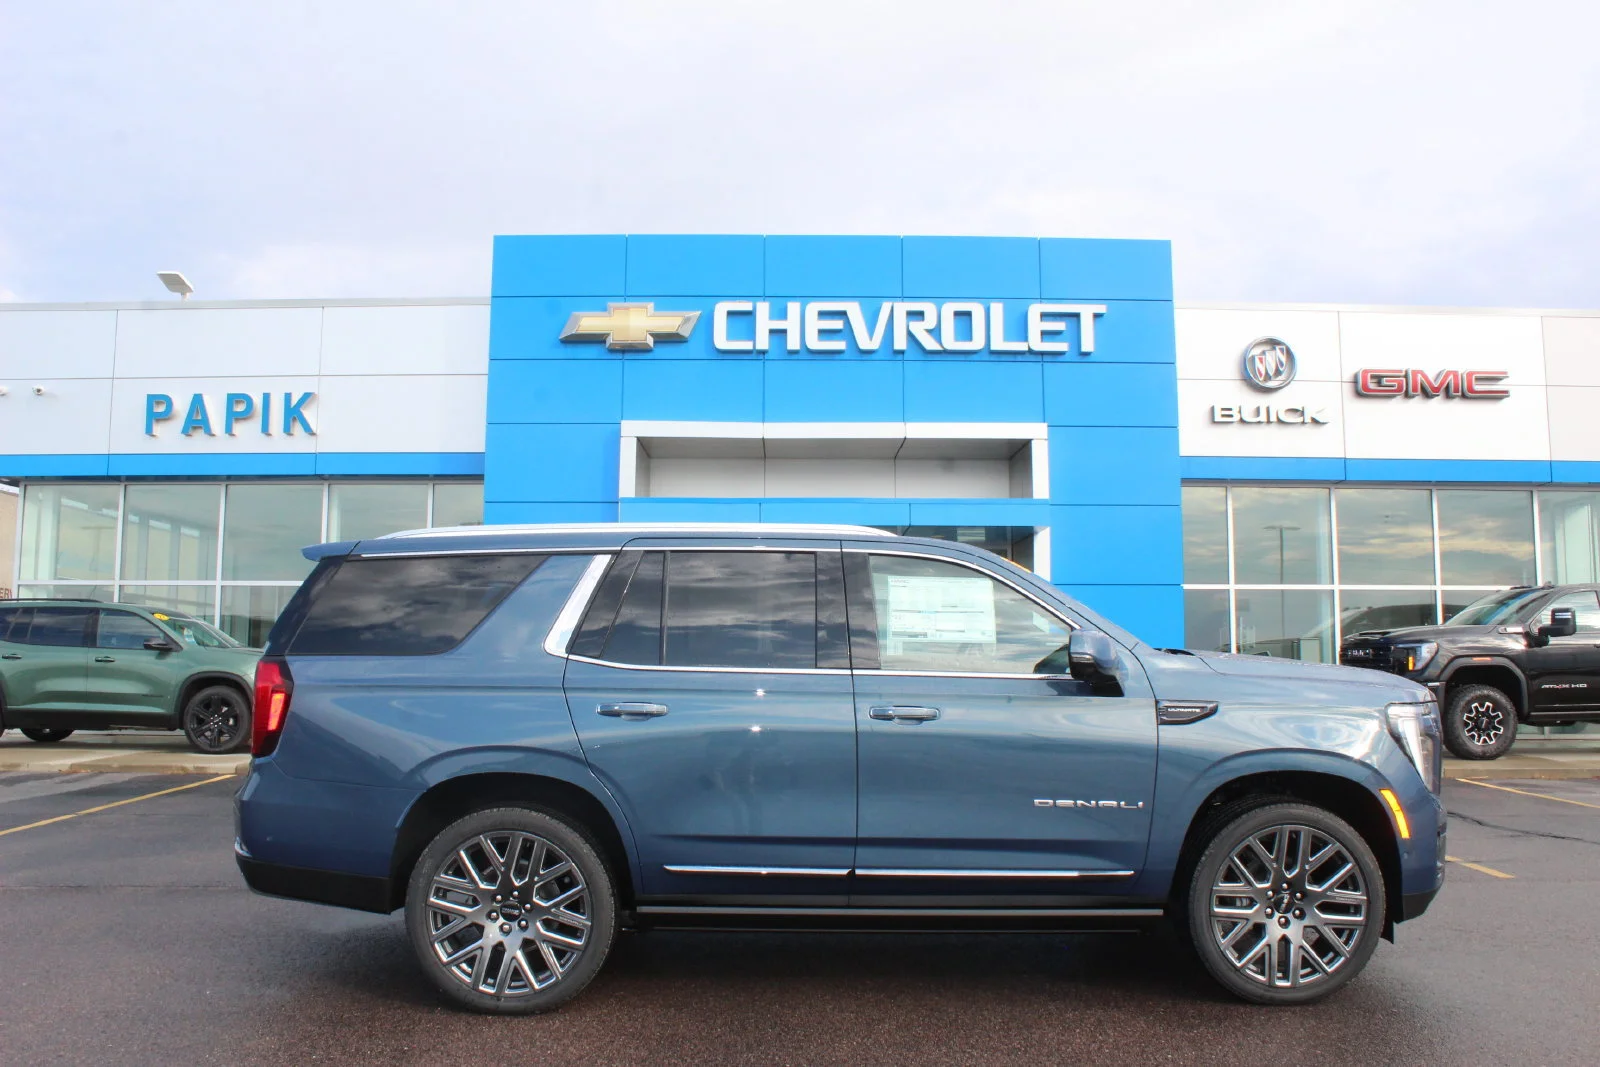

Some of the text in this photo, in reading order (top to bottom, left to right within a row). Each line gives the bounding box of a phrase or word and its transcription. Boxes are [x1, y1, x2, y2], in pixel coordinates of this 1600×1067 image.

[713, 301, 1108, 353] CHEVROLET
[1354, 368, 1510, 399] GMC
[145, 391, 317, 436] PAPIK
[1211, 404, 1328, 424] BUICK
[1033, 799, 1144, 809] DENALI
